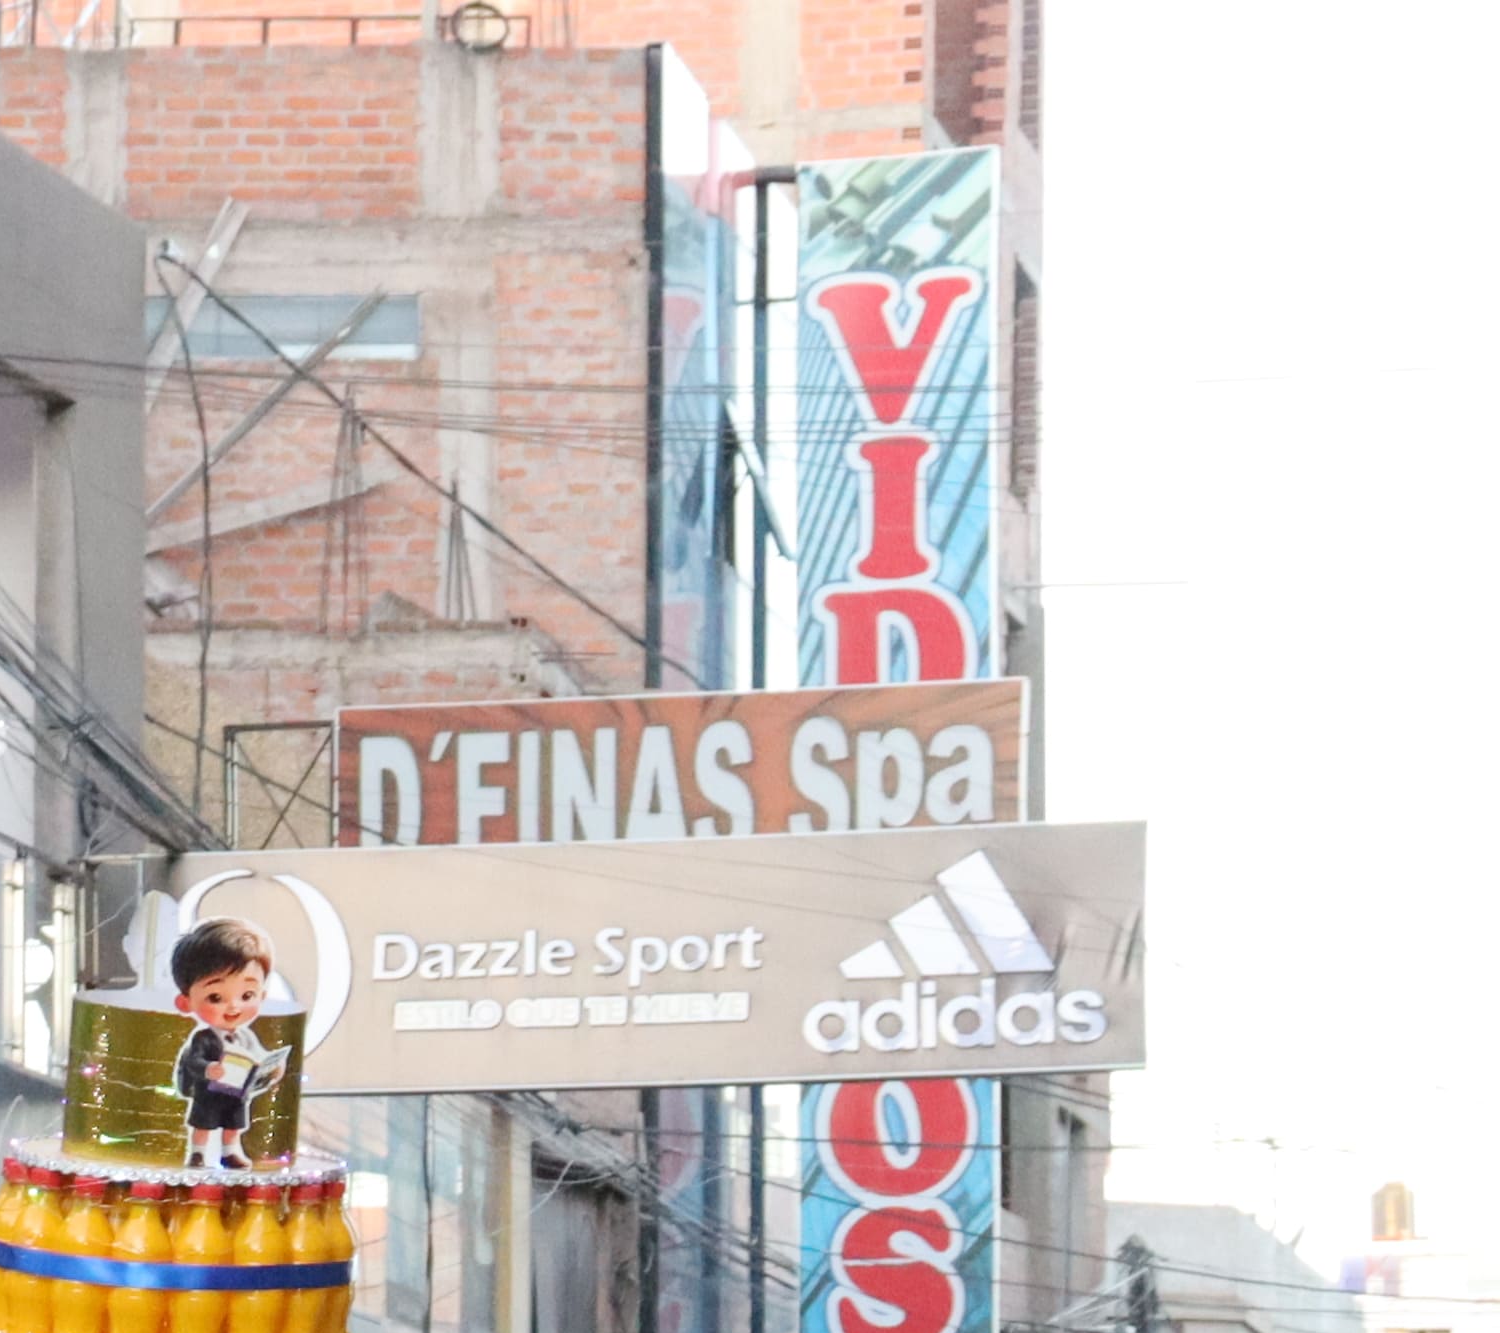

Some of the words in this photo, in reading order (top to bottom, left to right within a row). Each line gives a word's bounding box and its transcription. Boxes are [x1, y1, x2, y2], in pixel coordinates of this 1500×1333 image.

[790, 716, 992, 836] Spa
[371, 929, 575, 983] Dazzle
[592, 924, 766, 988] Sport
[803, 977, 1108, 1055] adidas
